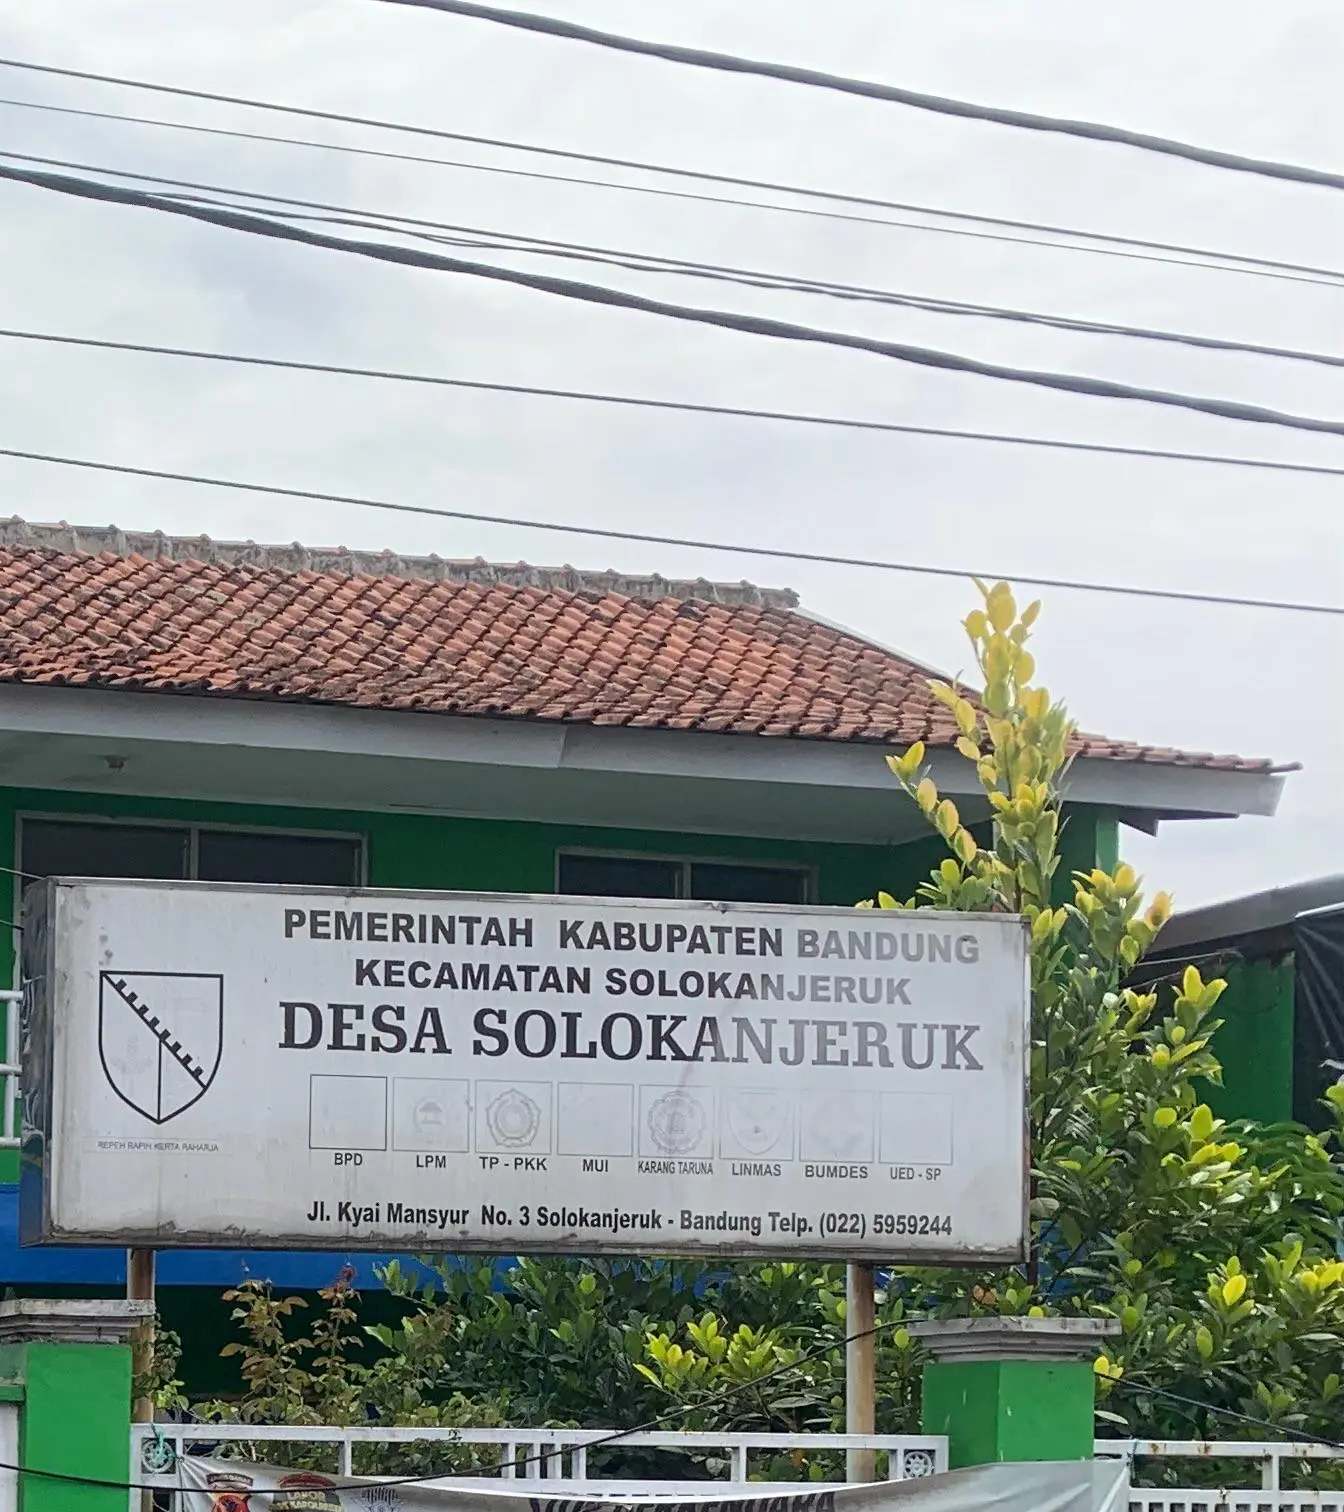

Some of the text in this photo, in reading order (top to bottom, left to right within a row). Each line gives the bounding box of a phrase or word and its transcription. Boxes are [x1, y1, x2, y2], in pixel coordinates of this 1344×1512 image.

[283, 908, 980, 964] PEMERINTAH KABUPATEN BANDUNG
[355, 960, 912, 1006] KECAMATAN SOLOKANJERUK
[278, 1001, 984, 1071] DESA SOLOKANJERUK
[334, 1153, 362, 1166] BPD
[416, 1155, 446, 1169] LPM
[479, 1157, 547, 1171] TP PKK
[582, 1159, 609, 1173] MUI
[638, 1161, 713, 1175] KARANG TARUNA
[732, 1163, 781, 1177] LINMAS
[805, 1165, 868, 1179] BUMDES
[890, 1167, 941, 1181] UED SP
[307, 1201, 953, 1239] Jl. Kyai Mansyur No. 3 Solokanjeruk Bandung Telp. (022) 5959244
